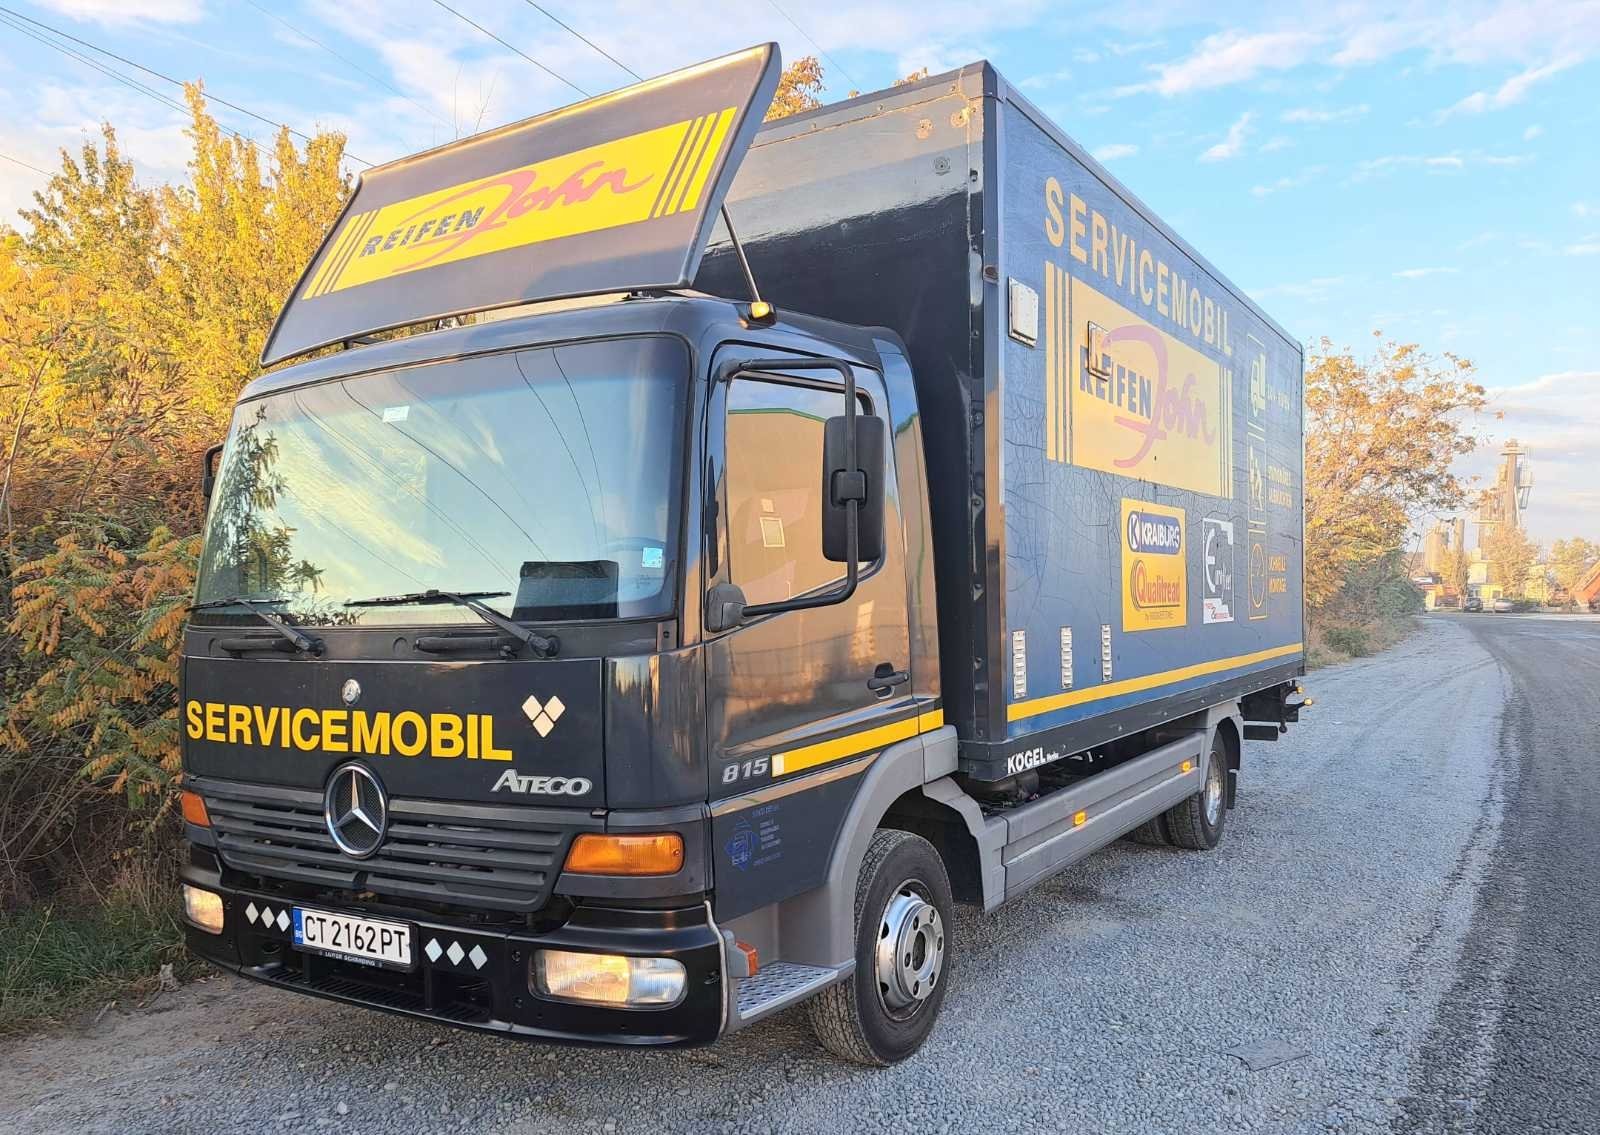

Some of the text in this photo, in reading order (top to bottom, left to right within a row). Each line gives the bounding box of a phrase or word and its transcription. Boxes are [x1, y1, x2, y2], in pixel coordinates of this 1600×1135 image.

[359, 207, 485, 258] REIFEN
[1045, 176, 1232, 356] SERVICEMOBIL
[1141, 522, 1180, 549] KRAIBURG
[186, 700, 512, 761] SERVICEMOBIL
[491, 768, 592, 796] ATEGO
[722, 757, 769, 783] 815
[305, 915, 406, 958] CT 2162 PT
